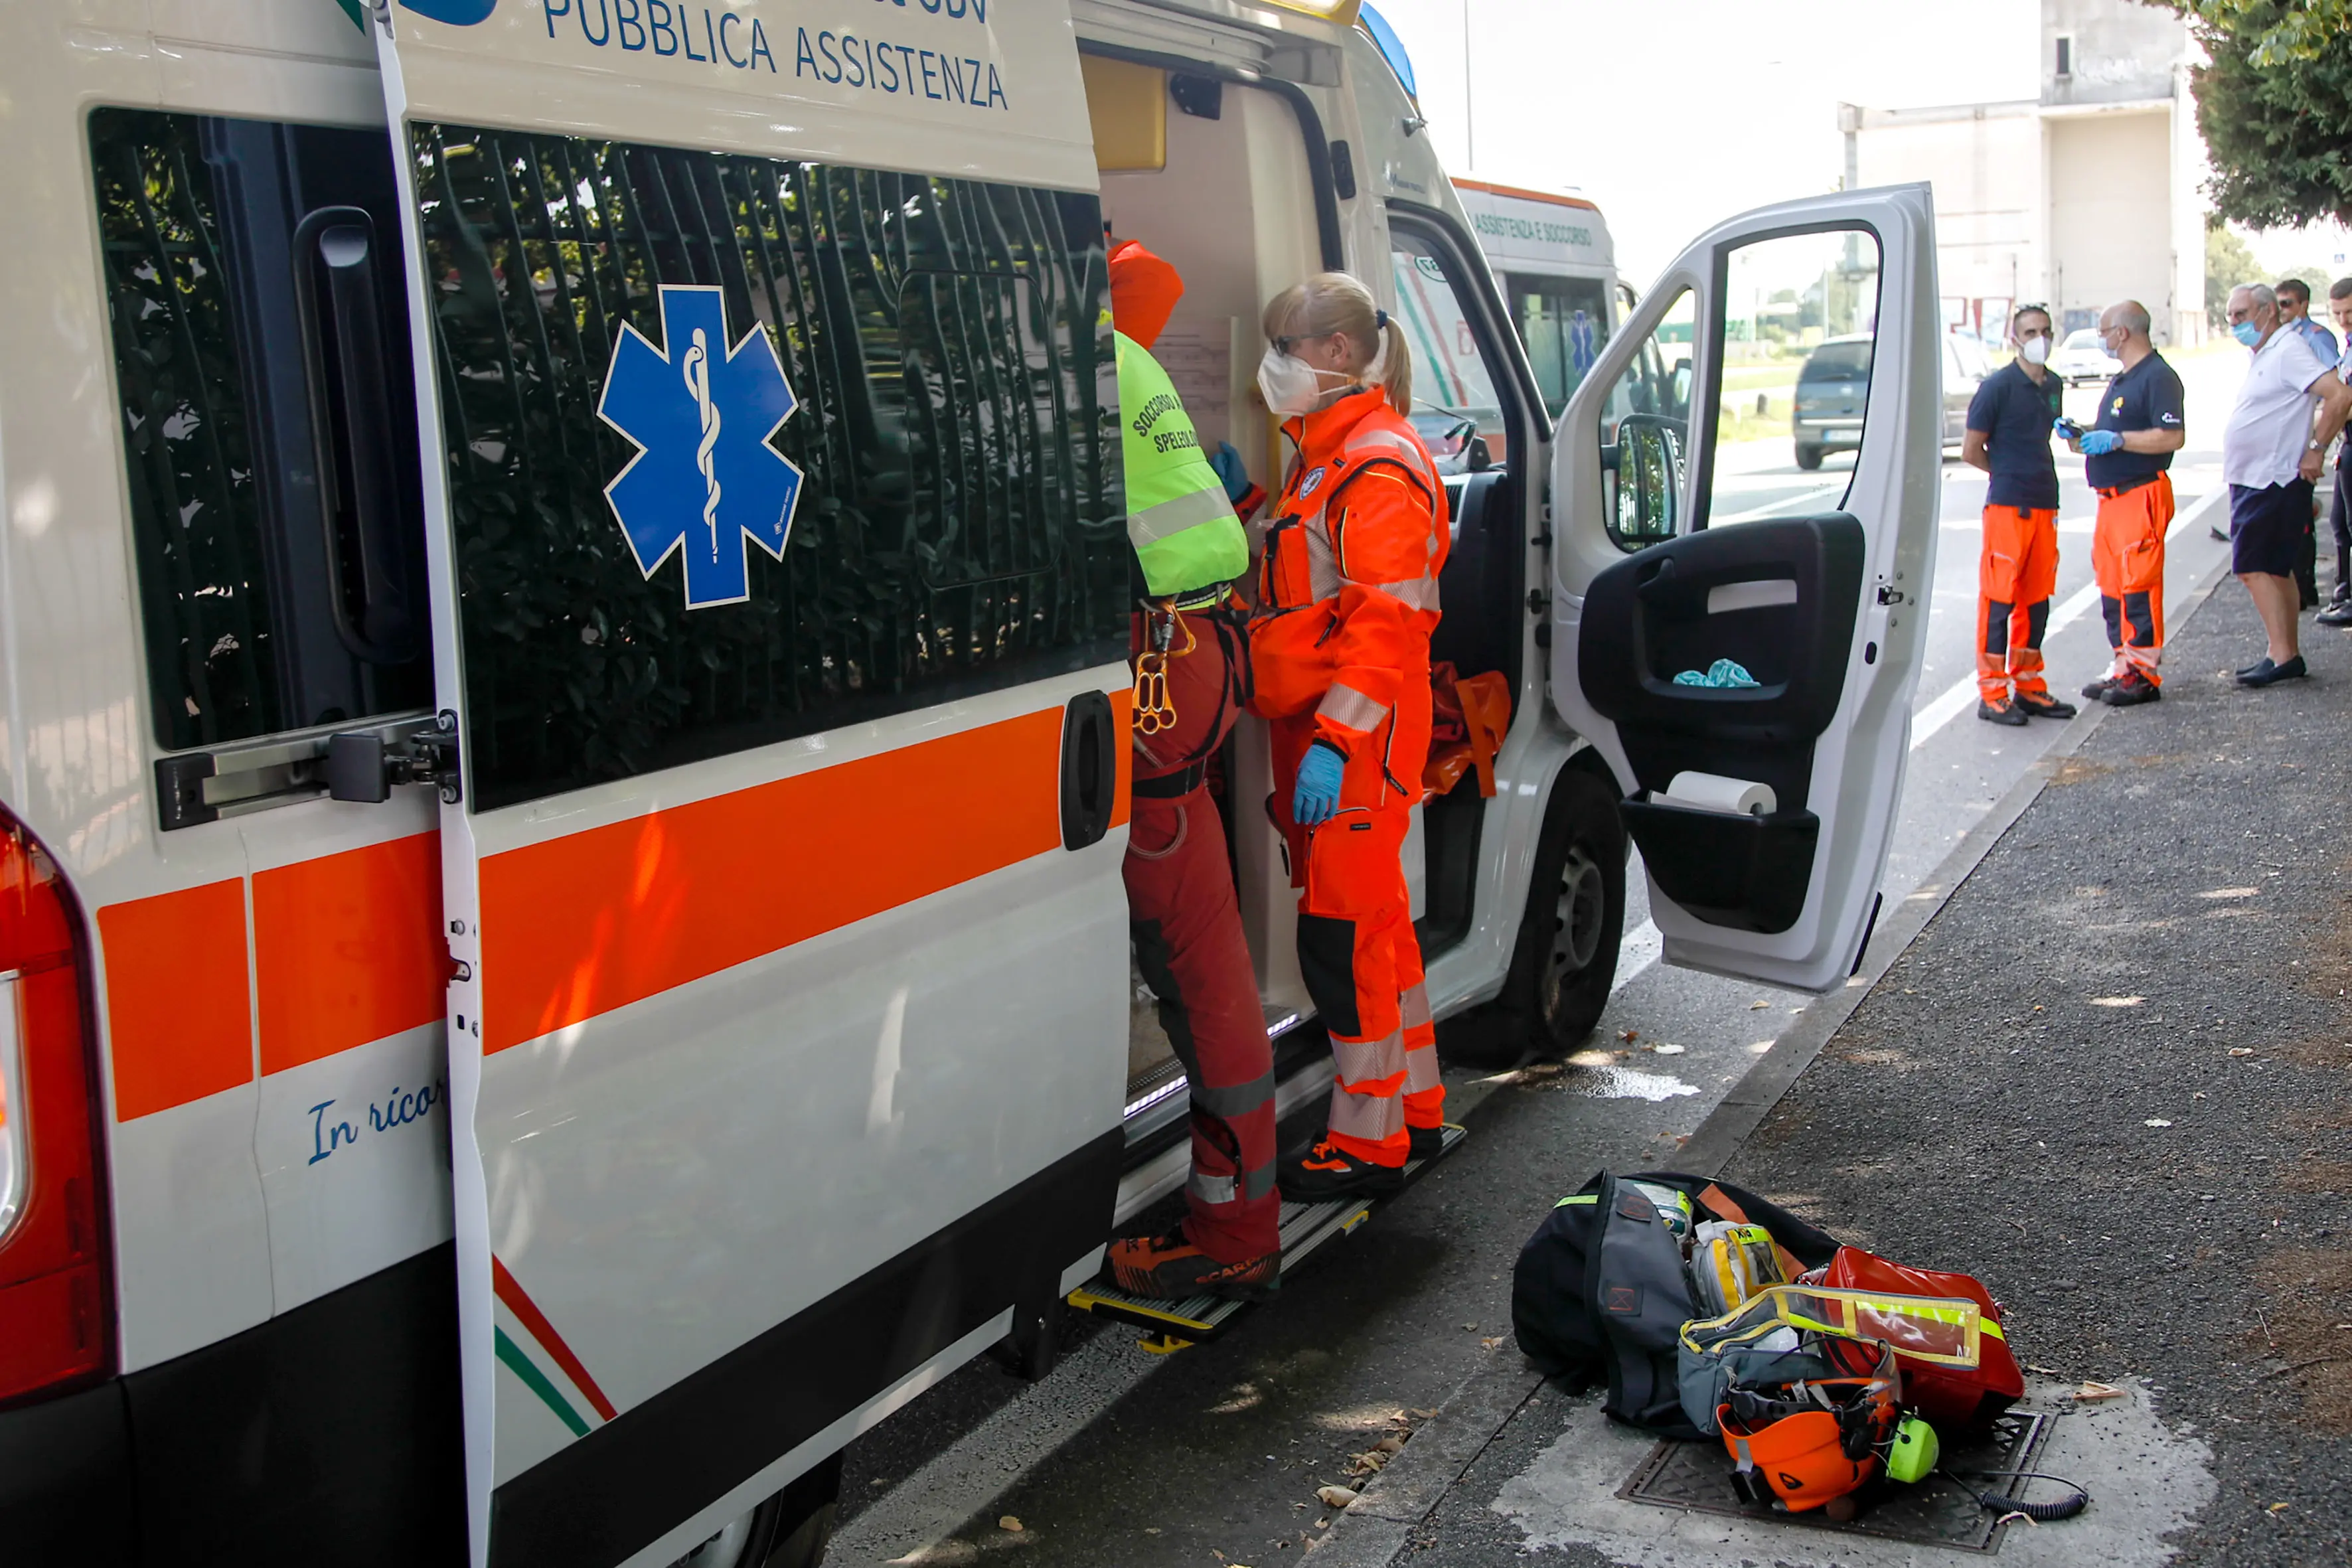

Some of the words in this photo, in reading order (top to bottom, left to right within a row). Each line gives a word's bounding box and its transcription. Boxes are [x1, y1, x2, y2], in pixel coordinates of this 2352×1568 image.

[544, 0, 777, 74] PUBBLICA
[796, 27, 1008, 110] ASSISTENZA
[1474, 213, 1535, 239] ASSISTENZA
[1535, 221, 1543, 241] E
[1543, 222, 1592, 247] SOCCORSO
[1132, 394, 1176, 437] SOCCORSO
[307, 1099, 358, 1166] In
